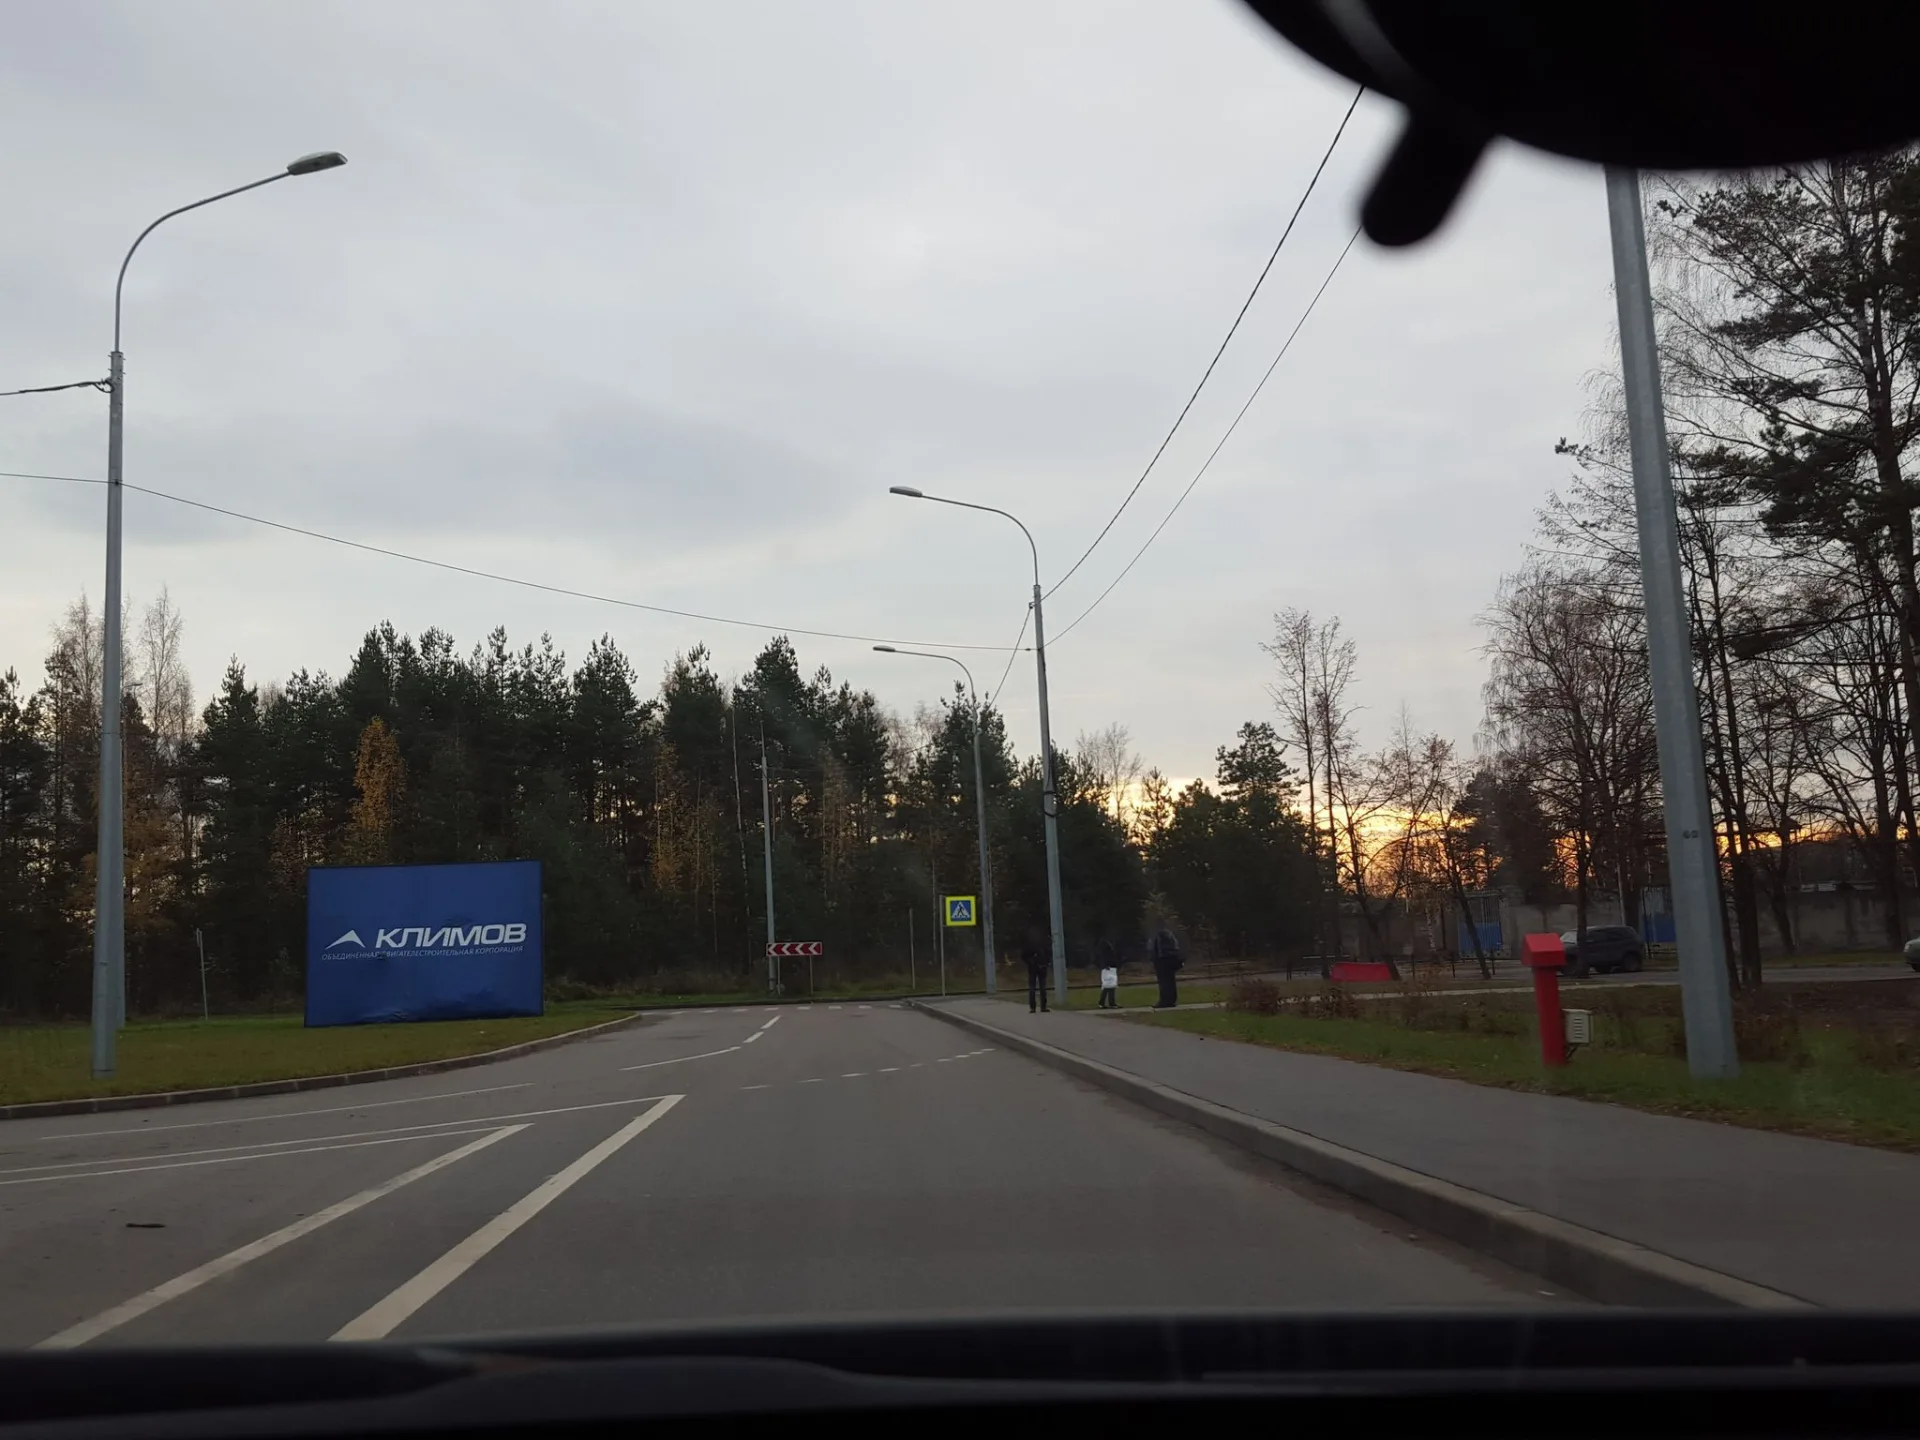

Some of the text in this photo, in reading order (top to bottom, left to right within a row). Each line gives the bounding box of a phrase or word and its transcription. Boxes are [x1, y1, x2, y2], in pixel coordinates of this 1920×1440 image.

[375, 923, 527, 948] КЛИМОВ
[380, 947, 475, 959] ВИГАТЕЛЕСТРОИТЕЛЬНАЯ
[475, 945, 524, 955] КОРПОРАЦИЯ
